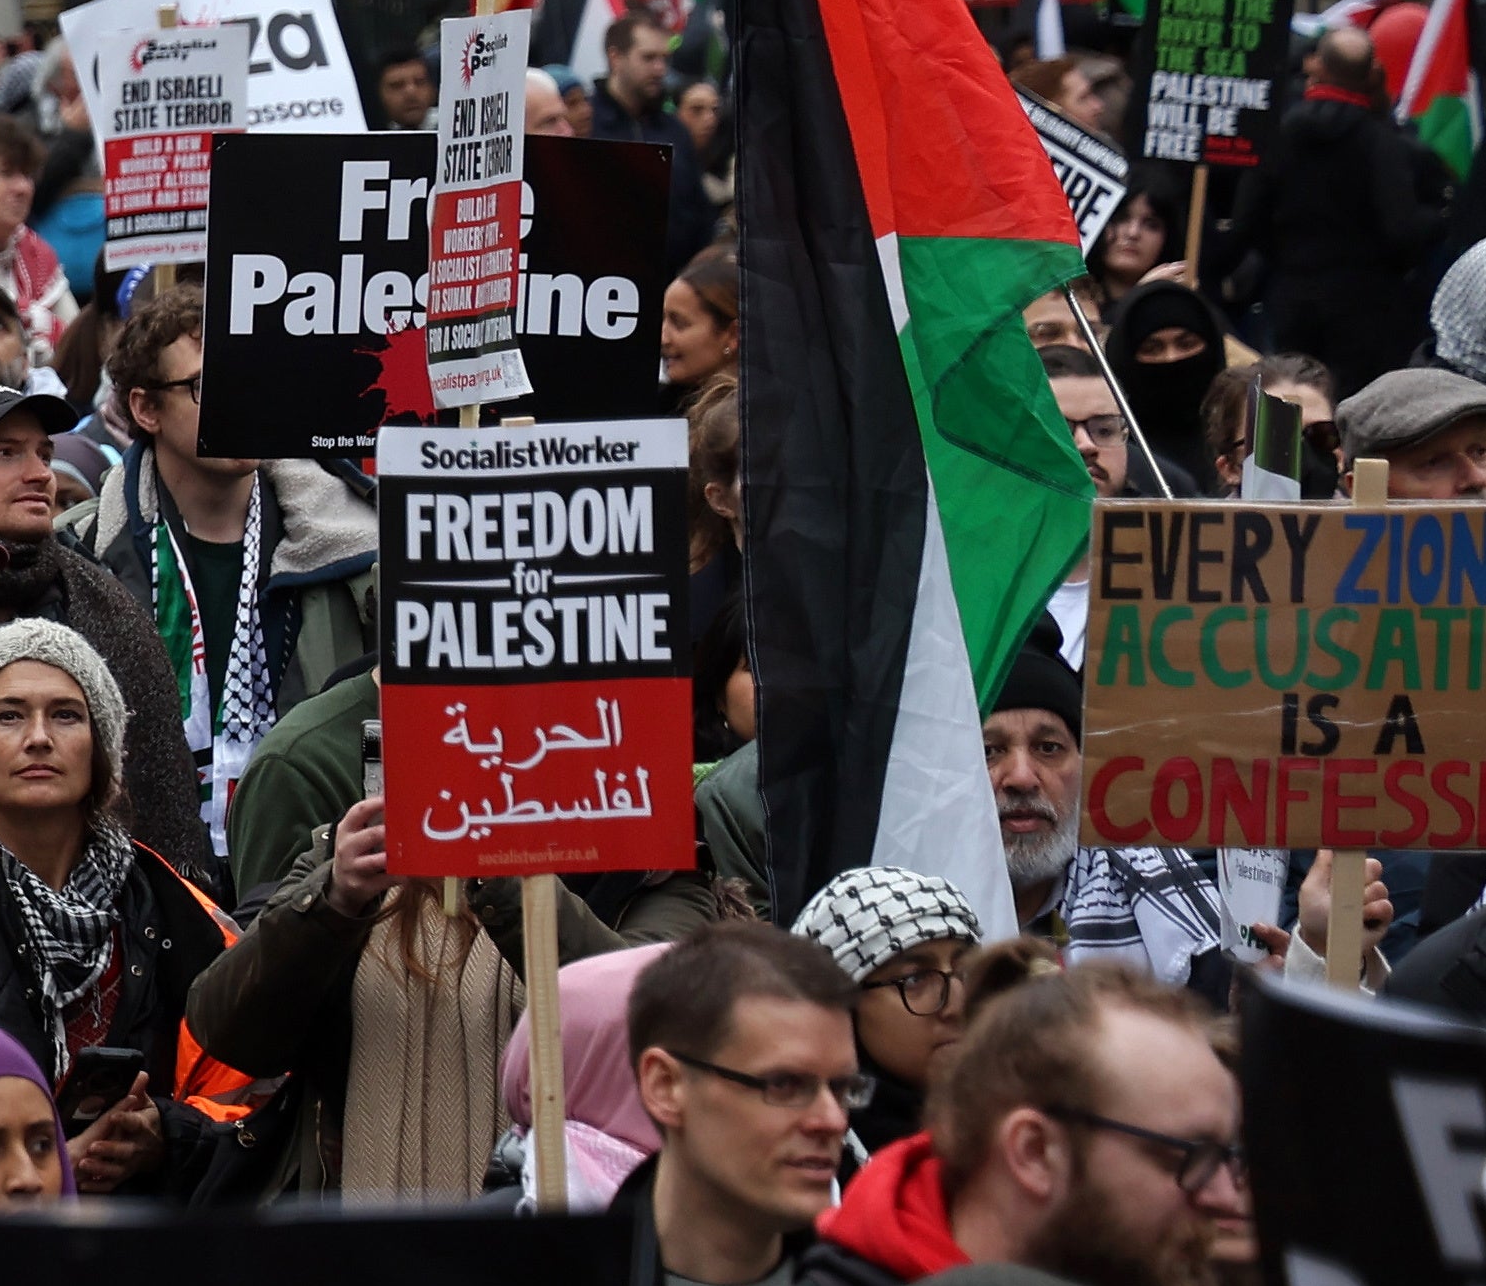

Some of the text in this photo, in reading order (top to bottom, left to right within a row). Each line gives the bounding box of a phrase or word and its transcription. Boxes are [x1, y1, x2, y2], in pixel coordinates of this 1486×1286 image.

[148, 39, 217, 51] Socialist
[1157, 18, 1262, 51] RIVER TO
[1155, 46, 1249, 78] THE SEA
[122, 75, 222, 105] END ISRAELI
[1148, 71, 1271, 111] PALESTINE
[114, 102, 232, 132] STATE TERROR
[453, 97, 475, 138] END
[1147, 102, 1240, 136] WILL BE
[444, 139, 482, 184] STATE
[1143, 129, 1201, 161] FREE
[406, 486, 654, 561] FREEDOM
[1100, 511, 1324, 604] EVERY
[510, 562, 554, 596] for
[396, 593, 672, 669] PALESTINE
[1280, 693, 1425, 757] IS A
